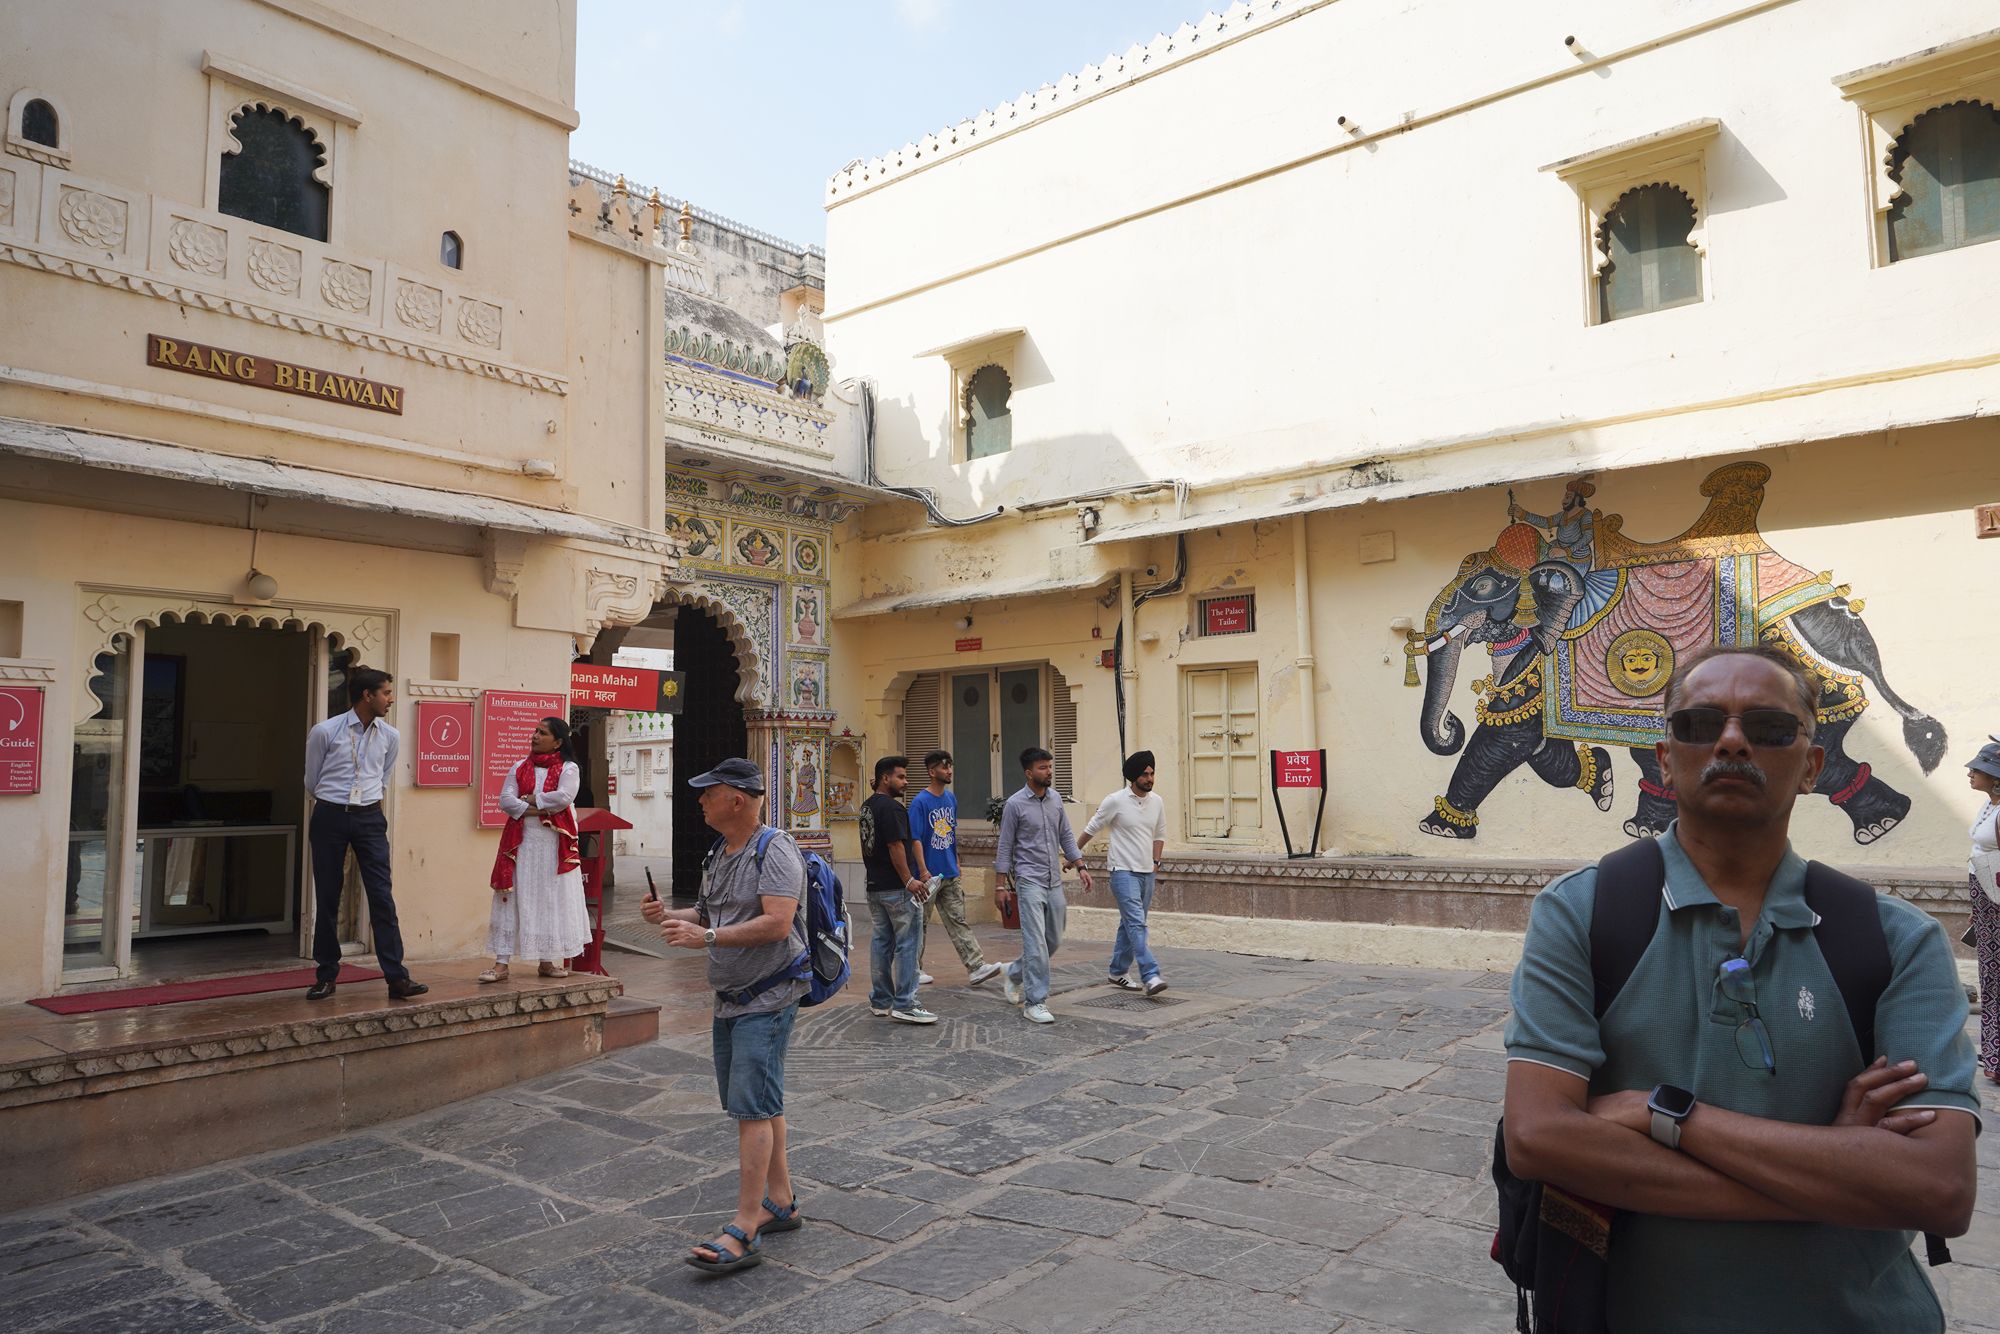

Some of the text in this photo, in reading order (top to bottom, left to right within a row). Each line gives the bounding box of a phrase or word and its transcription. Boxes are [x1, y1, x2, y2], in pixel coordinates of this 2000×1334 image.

[156, 338, 400, 410] RANG BHAWAN
[1211, 607, 1245, 617] The Palace
[1218, 618, 1238, 626] Tailor
[602, 674, 638, 687] Mahal
[594, 690, 617, 702] महल
[492, 697, 558, 709] Information Desk
[0, 738, 35, 747] Guide
[420, 752, 470, 761] Information
[1286, 752, 1310, 765] प्रवेश
[431, 763, 459, 773] Centre
[1285, 772, 1312, 786] Entry
